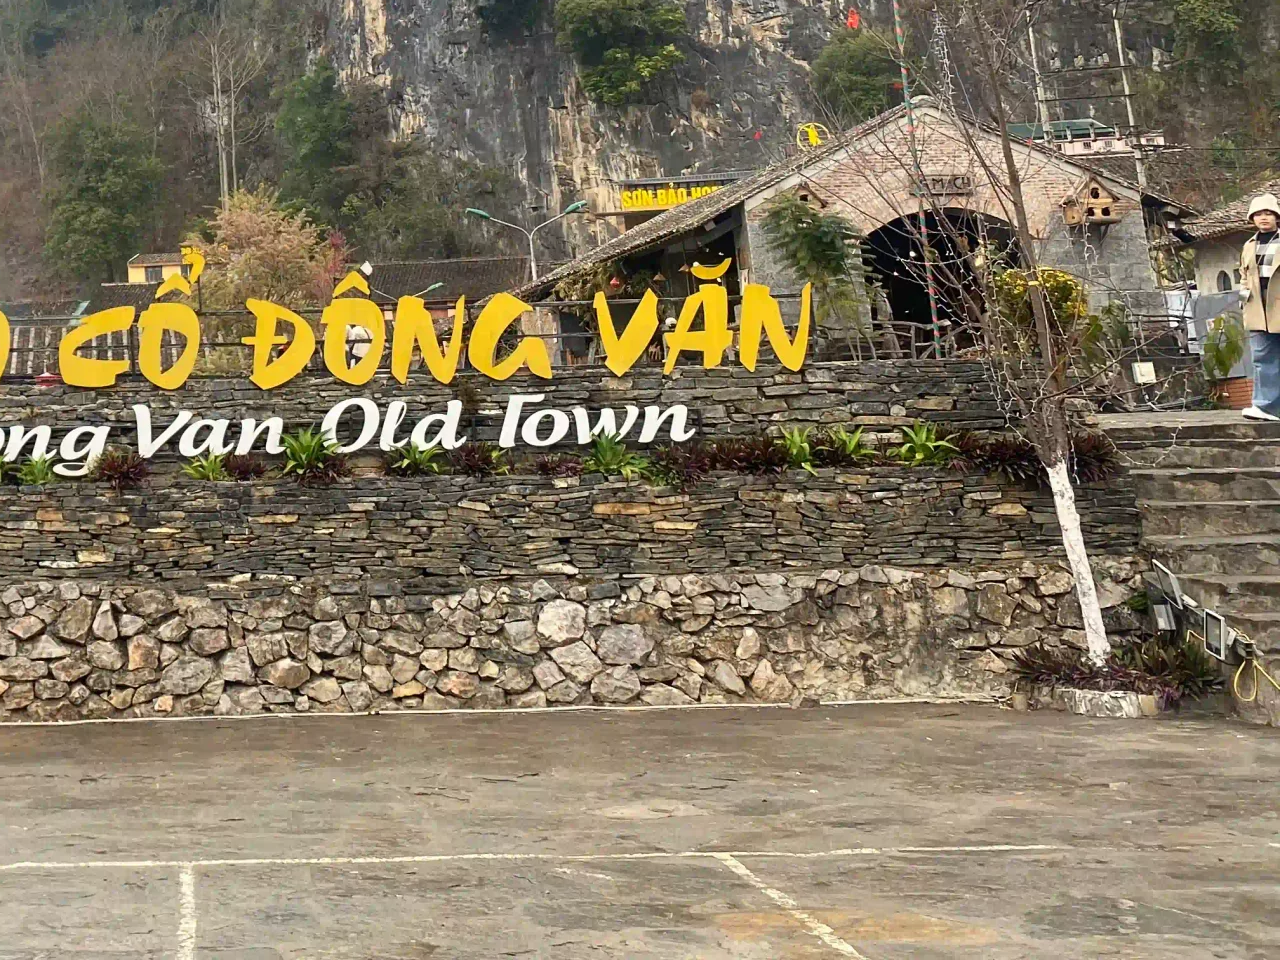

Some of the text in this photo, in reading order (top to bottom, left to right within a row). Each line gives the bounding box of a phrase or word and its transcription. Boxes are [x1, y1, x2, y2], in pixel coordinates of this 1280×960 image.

[657, 182, 688, 205] BẢO
[58, 253, 206, 390] CỔ
[593, 257, 812, 377] VĂN
[131, 404, 287, 458] Van
[320, 397, 467, 454] Old
[498, 393, 696, 448] Town
